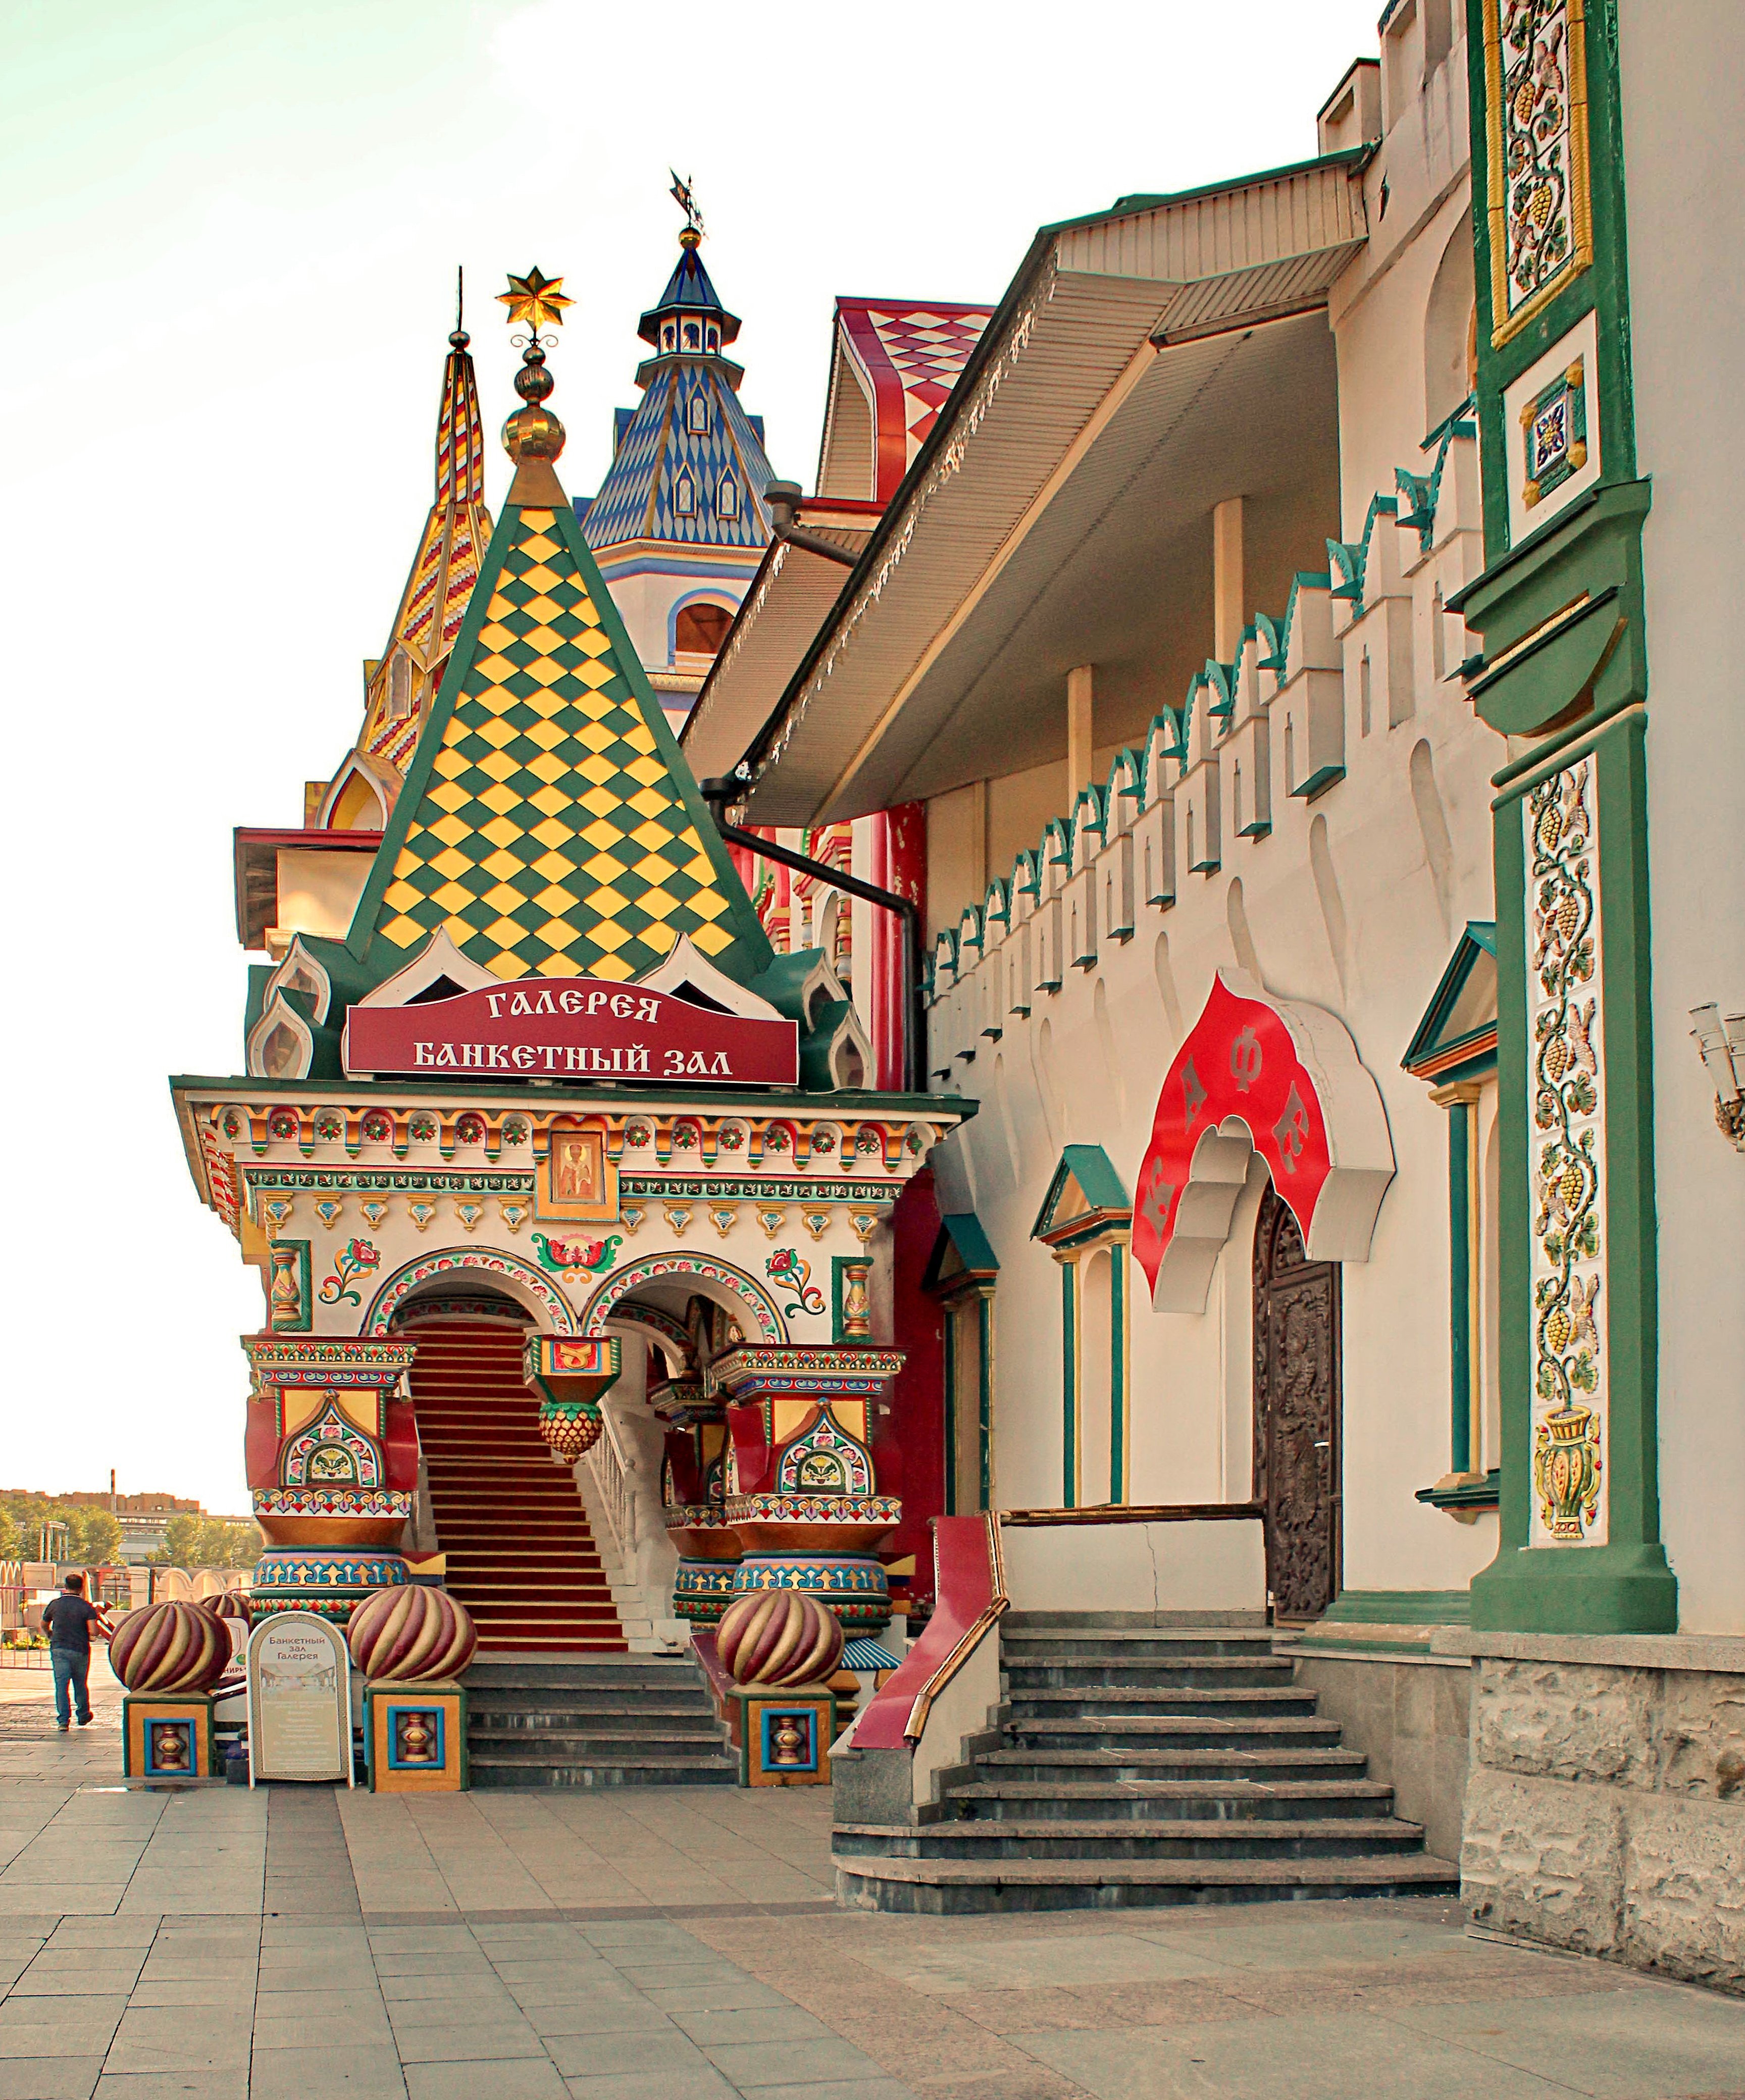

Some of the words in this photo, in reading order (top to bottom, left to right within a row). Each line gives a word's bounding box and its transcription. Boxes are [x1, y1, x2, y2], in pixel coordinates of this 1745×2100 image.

[485, 990, 662, 1023] ГАЛЕРЕЯ
[413, 1042, 650, 1072] БАНКЕТНЫЙ
[663, 1049, 733, 1076] ЗАЛ
[278, 1652, 318, 1660] Галерея
